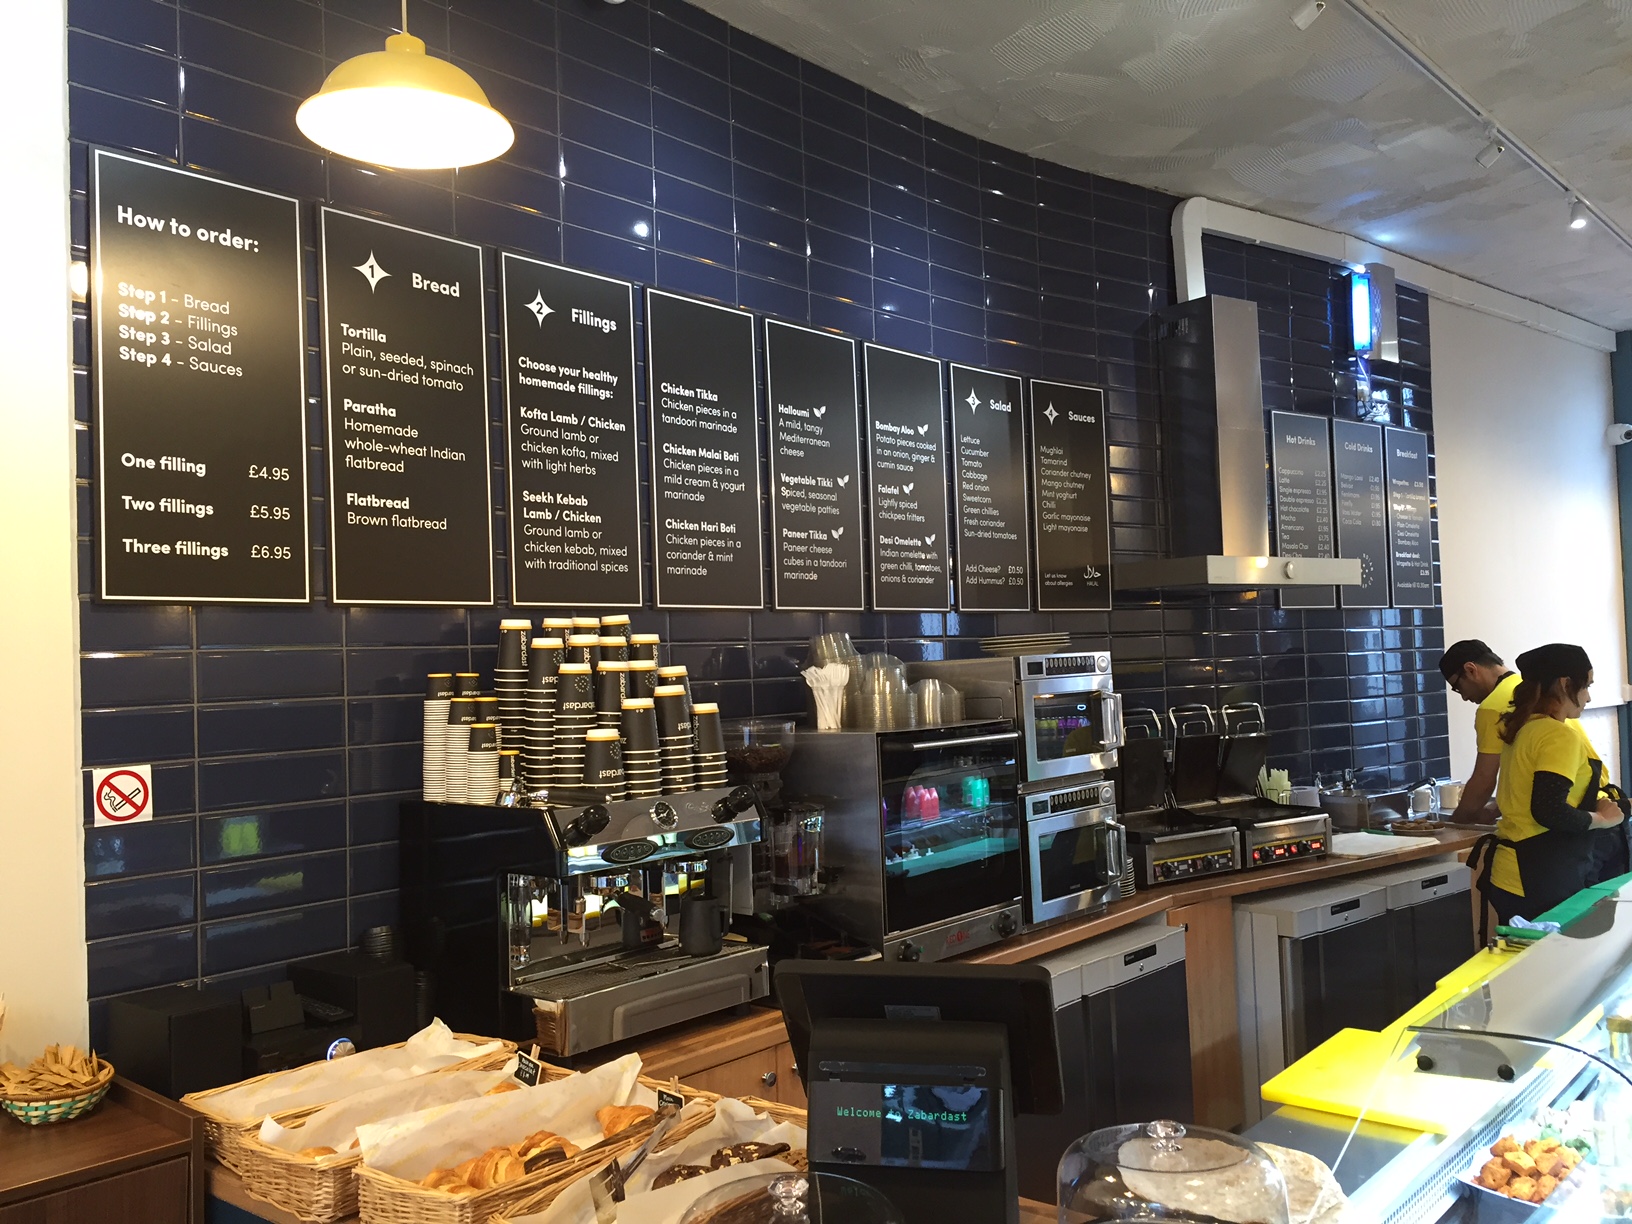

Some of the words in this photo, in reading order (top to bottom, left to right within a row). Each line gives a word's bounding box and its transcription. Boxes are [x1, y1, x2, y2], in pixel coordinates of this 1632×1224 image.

[118, 205, 165, 232] How
[170, 218, 191, 238] to
[197, 228, 259, 253] order:
[369, 265, 374, 278] 1
[412, 273, 460, 298] Bread
[119, 282, 156, 305] Step
[160, 291, 166, 304] 1
[184, 294, 230, 315] Bread
[119, 304, 156, 326] Step
[160, 311, 170, 325] 2
[188, 315, 238, 339] Fillings
[536, 302, 543, 315] 2
[572, 308, 617, 334] Fillings
[119, 324, 157, 346] Step
[161, 332, 171, 346] 3
[188, 336, 232, 356] Salad
[341, 323, 387, 343] Tortilla
[120, 346, 158, 368] Step
[161, 353, 172, 367] 4
[190, 356, 243, 377] Sauces
[342, 342, 376, 362] Plain,
[380, 352, 427, 370] seeded,
[430, 360, 474, 376] spinach
[342, 364, 357, 375] or
[359, 367, 419, 385] sun-dried
[422, 375, 464, 392] tomato
[518, 356, 557, 373] Choose
[558, 366, 581, 378] your
[582, 367, 618, 387] healthy
[519, 372, 576, 393] homemade
[578, 383, 614, 400] fillings:
[661, 382, 695, 398] Chicken
[696, 388, 718, 402] Tikka
[344, 398, 397, 418] Paratha
[661, 397, 694, 412] Chicken
[696, 404, 721, 417] pieces
[723, 408, 730, 418] in
[778, 404, 810, 418] Halloumi
[990, 399, 1012, 413] Salad
[520, 406, 548, 421] Kofta
[551, 411, 579, 425] Lamb
[580, 416, 586, 426] /
[588, 417, 626, 432] Chicken
[662, 413, 698, 428] tandoori
[699, 421, 738, 434] marinade
[1068, 411, 1096, 424] Sauces
[345, 417, 419, 438] Homemade
[520, 423, 559, 439] Ground
[562, 428, 587, 443] lamb
[589, 435, 600, 444] or
[778, 418, 785, 427] A
[785, 420, 803, 432] mild,
[804, 422, 824, 436] tangy
[875, 420, 901, 435] Bombay
[900, 425, 915, 436] Aloo
[779, 431, 831, 448] Mediterranean
[876, 433, 896, 445] Potato
[897, 438, 916, 448] pieces
[916, 442, 937, 452] cooked
[960, 434, 981, 445] Lettuce
[344, 437, 428, 457] whole-wheat
[430, 446, 466, 461] Indian
[521, 440, 559, 455] chicken
[561, 444, 588, 460] kofta,
[591, 450, 619, 462] mixed
[663, 443, 697, 457] Chicken
[698, 448, 722, 460] Malai
[723, 451, 739, 462] Boti
[780, 445, 805, 458] cheese
[960, 446, 990, 458] Cucumber
[121, 453, 156, 469] One
[159, 456, 206, 478] filling
[249, 465, 290, 481] £4.95
[345, 455, 404, 473] flatbread
[521, 458, 544, 470] with
[546, 459, 568, 475] light
[569, 462, 597, 476] herbs
[877, 461, 896, 469] cumin
[896, 464, 914, 472] sauce
[961, 457, 983, 469] Tomato
[1040, 456, 1068, 467] Tamarind
[664, 474, 683, 485] mild
[684, 478, 711, 488] cream
[712, 478, 719, 489] &
[720, 482, 745, 493] yogurt
[780, 473, 816, 486] Vegetable
[817, 477, 833, 488] Tikki
[962, 469, 988, 482] Cabbage
[1041, 478, 1063, 490] Mango
[1063, 480, 1085, 491] chutney
[781, 486, 807, 500] Spiced,
[808, 492, 838, 502] seasonal
[878, 484, 900, 495] Falafel
[962, 481, 974, 491] Red
[347, 493, 410, 510] Flatbread
[523, 490, 554, 504] Seekh
[556, 493, 588, 507] Kebab
[664, 490, 705, 502] marinade
[878, 497, 899, 510] Lightly
[899, 500, 918, 510] spiced
[962, 493, 992, 504] Sweetcorn
[1042, 500, 1056, 509] Chilli
[122, 496, 155, 512] Two
[159, 498, 214, 519] fillings
[250, 505, 291, 520] £5.95
[524, 507, 553, 520] Lamb
[555, 510, 560, 521] /
[562, 510, 602, 524] Chicken
[781, 503, 817, 514] vegetable
[818, 506, 840, 515] patties
[878, 510, 906, 522] chickpea
[906, 512, 926, 523] fritters
[348, 512, 388, 526] Brown
[391, 514, 447, 530] flatbread
[665, 518, 700, 531] Chicken
[701, 521, 719, 532] Hari
[720, 523, 736, 534] Boti
[783, 528, 809, 539] Paneer
[809, 530, 828, 541] Tikka
[880, 535, 894, 545] Desi
[894, 536, 922, 547] Omelette
[122, 538, 171, 554] Three
[175, 541, 229, 560] fillings
[251, 545, 291, 560] £6.95
[965, 564, 978, 573] Add
[1008, 566, 1024, 575] £0.50
[520, 630, 528, 666] zabardast
[836, 1106, 882, 1118] Welcome
[908, 1108, 968, 1122] Zabardast
